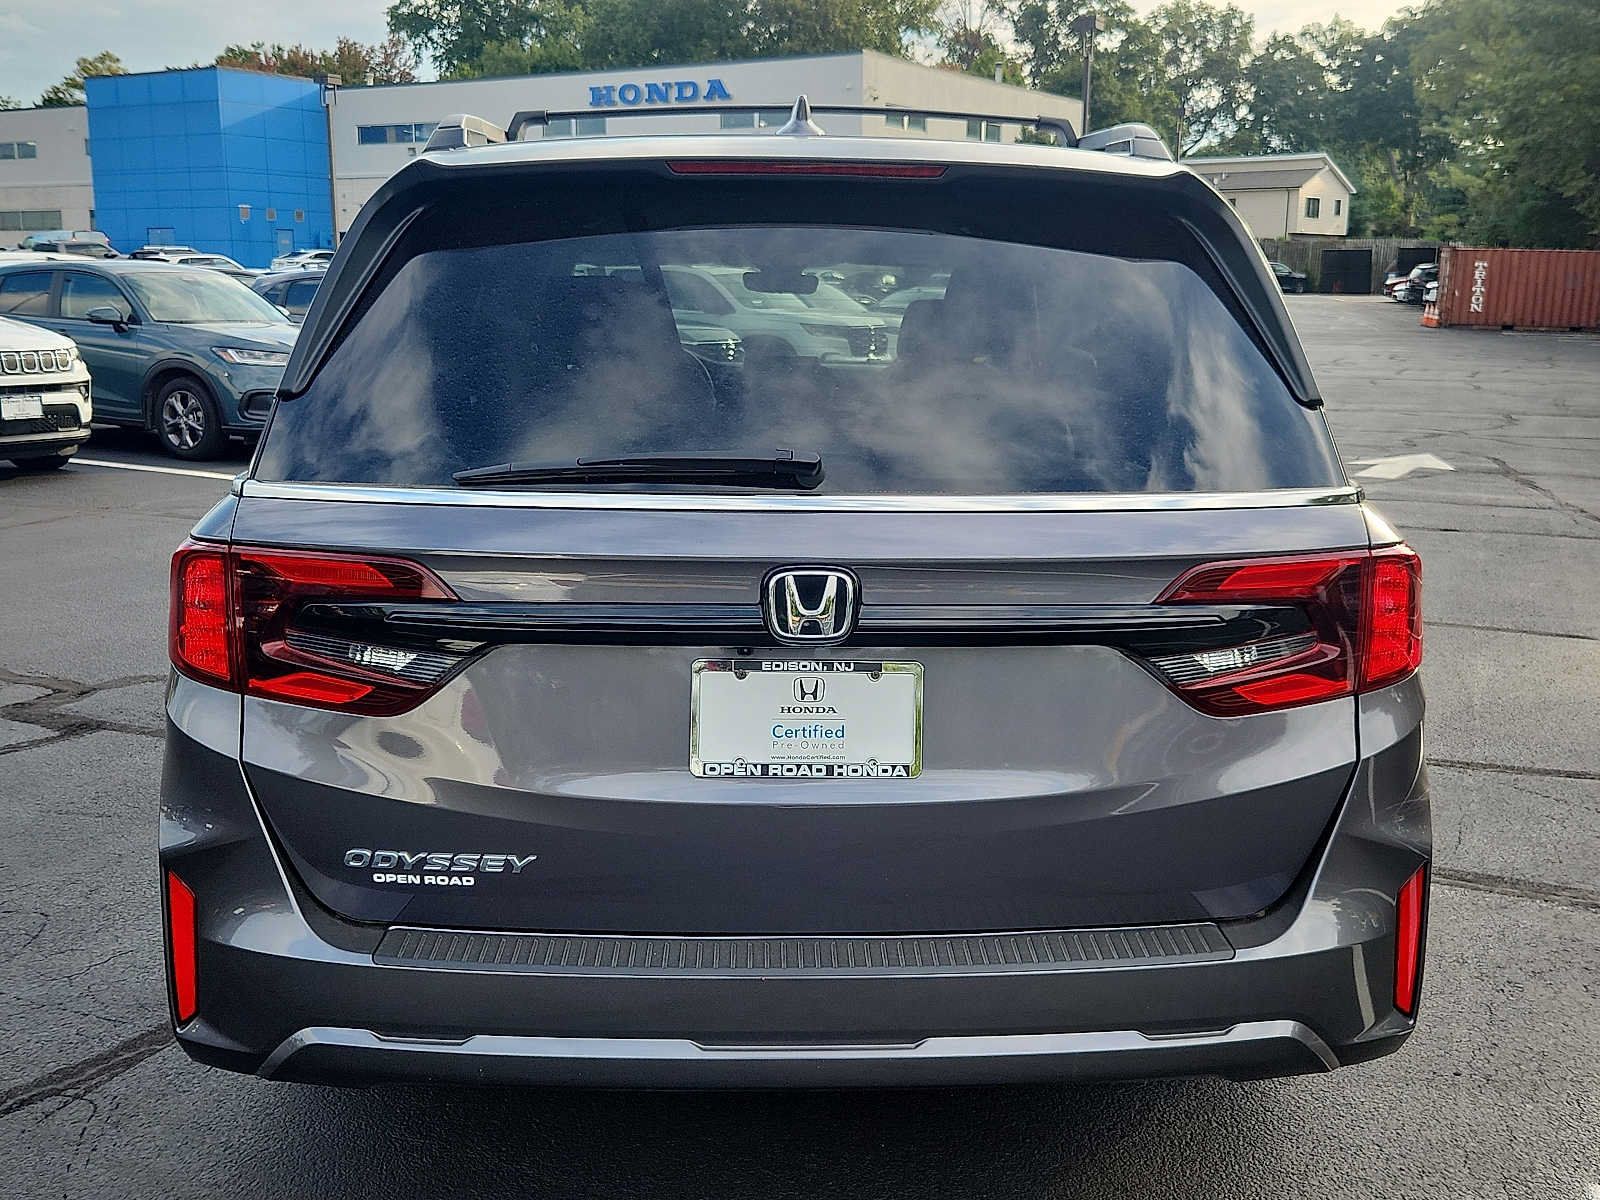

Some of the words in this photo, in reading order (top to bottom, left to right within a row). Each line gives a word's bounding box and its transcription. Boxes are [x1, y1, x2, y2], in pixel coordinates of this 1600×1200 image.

[589, 78, 732, 106] HONDA
[1470, 261, 1488, 313] TRITON
[761, 661, 828, 672] EDISON,
[833, 661, 855, 672] NJ
[779, 706, 838, 714] HONDA
[772, 724, 845, 739] Certified
[772, 741, 845, 750] Pre-Owned
[704, 764, 762, 777] OPEN
[768, 764, 827, 777] ROAD
[833, 764, 908, 777] HONDA
[343, 848, 537, 874] ODYSSEY
[372, 873, 421, 885] OPEN
[424, 875, 475, 886] ROAD
